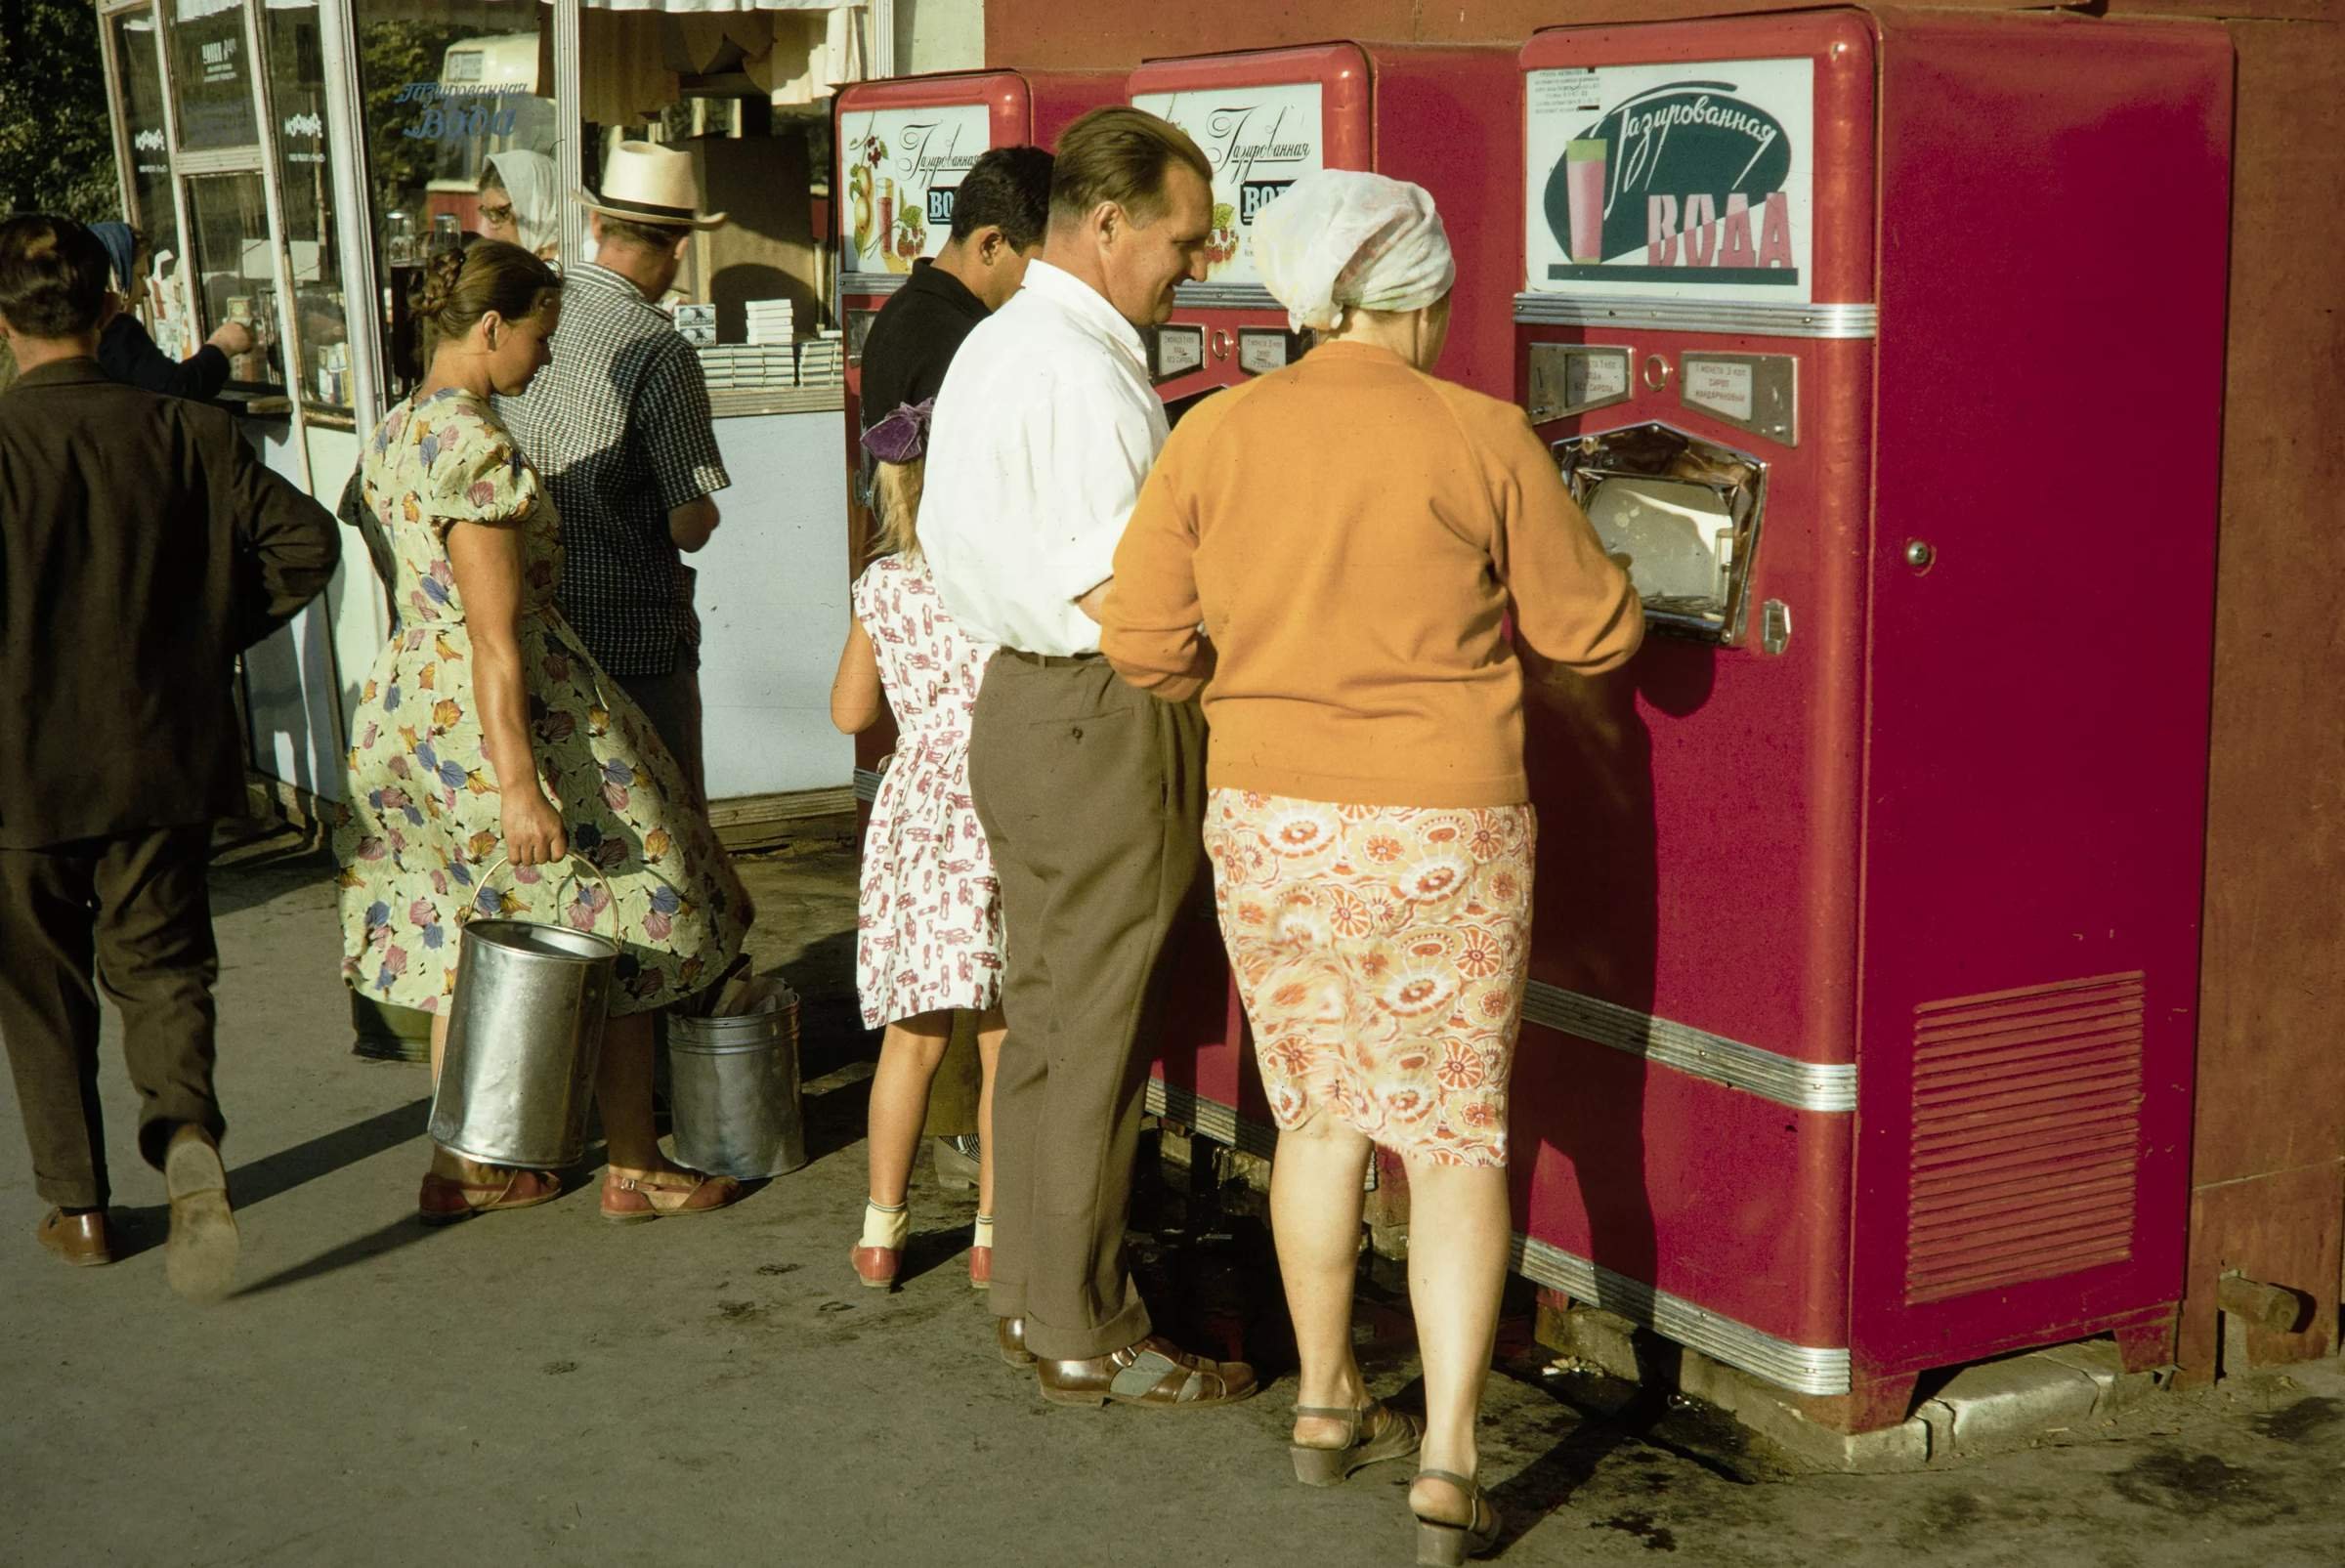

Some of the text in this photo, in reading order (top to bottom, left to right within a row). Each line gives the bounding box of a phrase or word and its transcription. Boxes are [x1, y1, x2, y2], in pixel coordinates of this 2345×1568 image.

[403, 106, 517, 139] Вода
[1205, 104, 1310, 185] Газированная
[1590, 93, 1776, 221] Газированная
[929, 191, 955, 218] ВО
[1243, 186, 1289, 217] ВО
[1647, 191, 1794, 269] ВОДА
